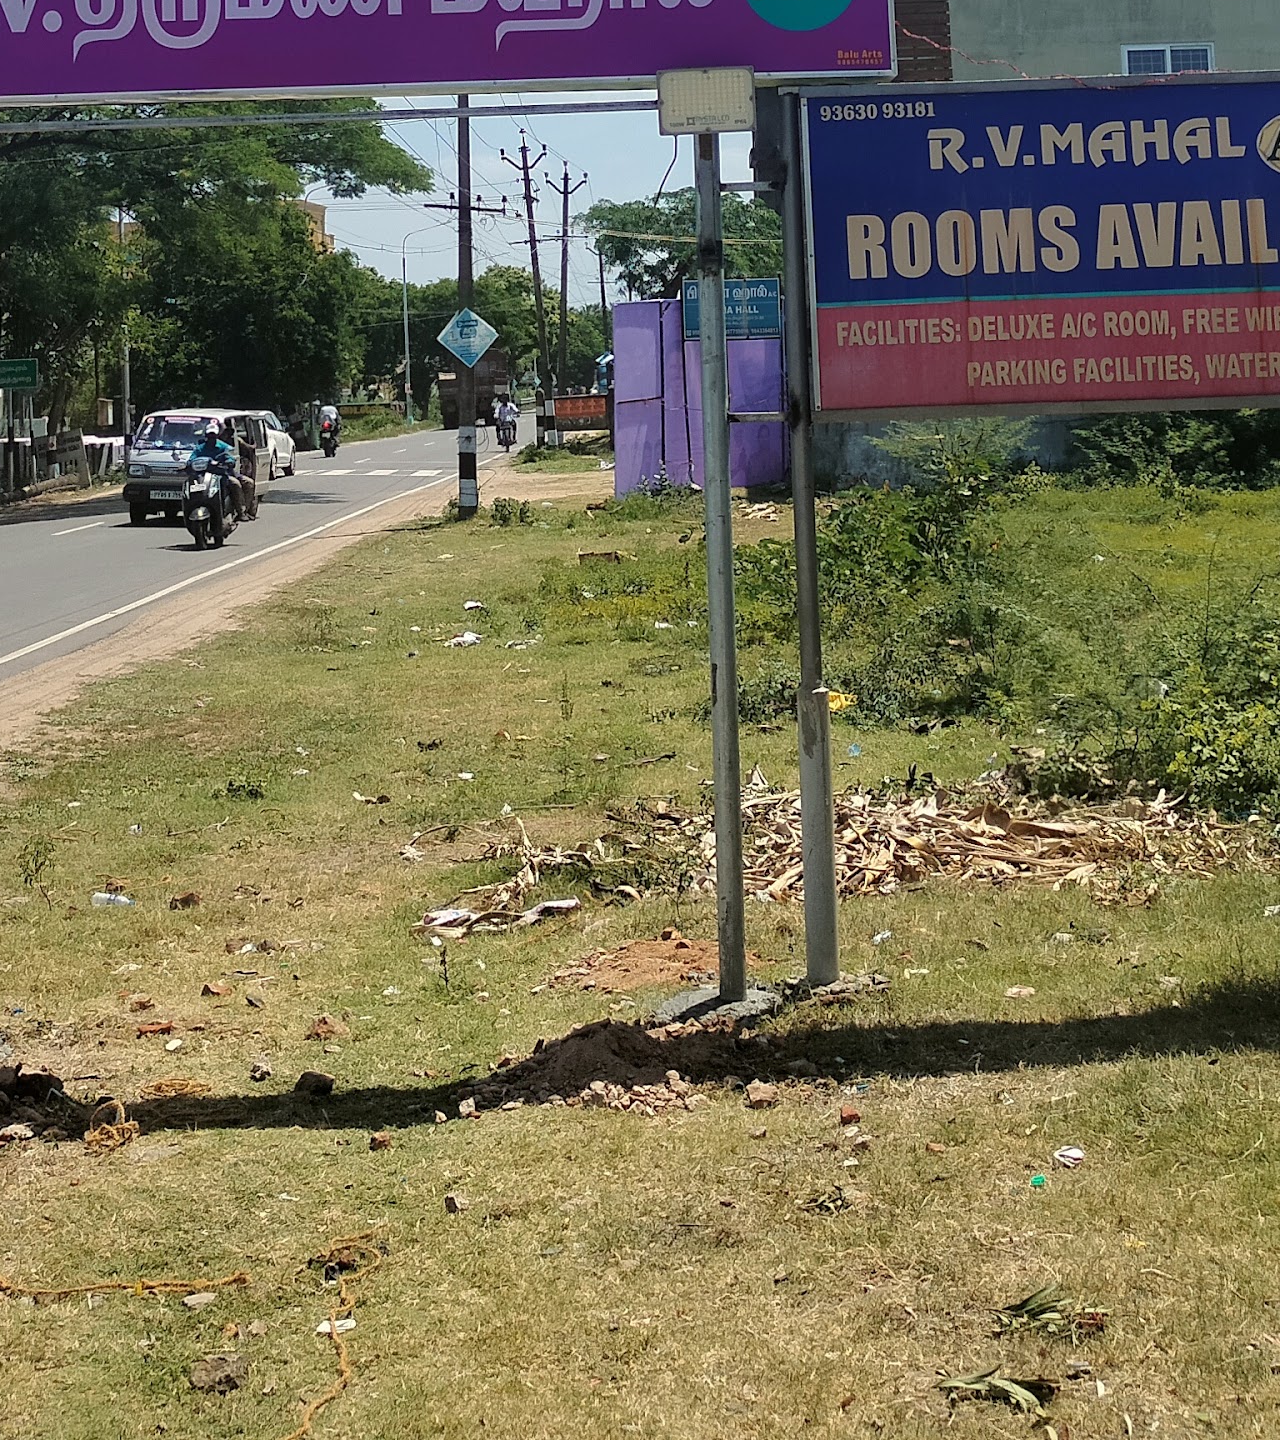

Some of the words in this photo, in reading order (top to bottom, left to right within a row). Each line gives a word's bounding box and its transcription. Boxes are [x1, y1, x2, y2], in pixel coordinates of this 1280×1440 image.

[837, 49, 859, 59] Balu
[861, 49, 883, 59] Arts
[819, 105, 878, 122] 93630
[882, 101, 936, 119] 93181
[846, 204, 1080, 280] ROOMS
[735, 305, 759, 314] HALL
[836, 317, 962, 347] FACILITIES:
[968, 314, 1056, 342] DELUXE
[1061, 311, 1097, 339] A/C
[1104, 309, 1177, 340] ROOM,
[1183, 307, 1240, 334] FREE
[967, 358, 1068, 388] PARKING
[1074, 355, 1200, 386] FACILITIES,
